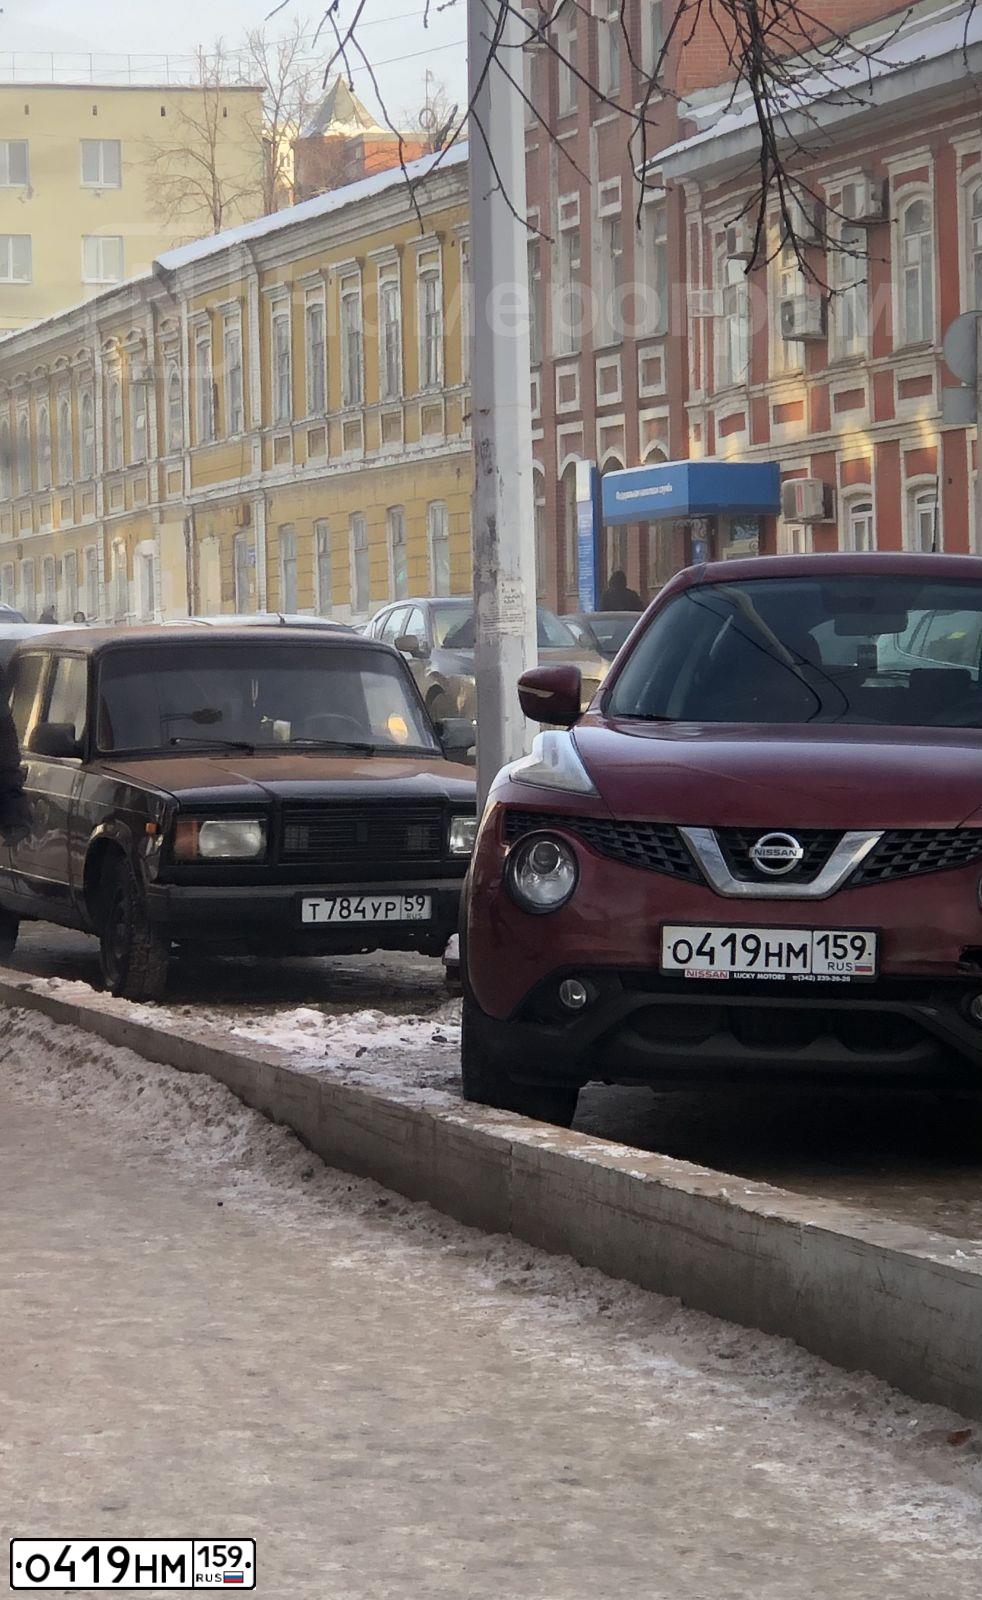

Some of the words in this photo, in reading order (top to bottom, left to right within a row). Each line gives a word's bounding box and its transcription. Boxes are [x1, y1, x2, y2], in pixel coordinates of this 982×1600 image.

[754, 848, 798, 857] NISSAN
[308, 897, 397, 920] Т784УР
[404, 895, 426, 912] 59
[672, 932, 808, 969] О419НМ
[815, 934, 867, 961] 159
[827, 962, 853, 972] RUS
[686, 970, 729, 979] NISSAN
[733, 972, 756, 980] LUCKY
[757, 973, 786, 981] MOTORS
